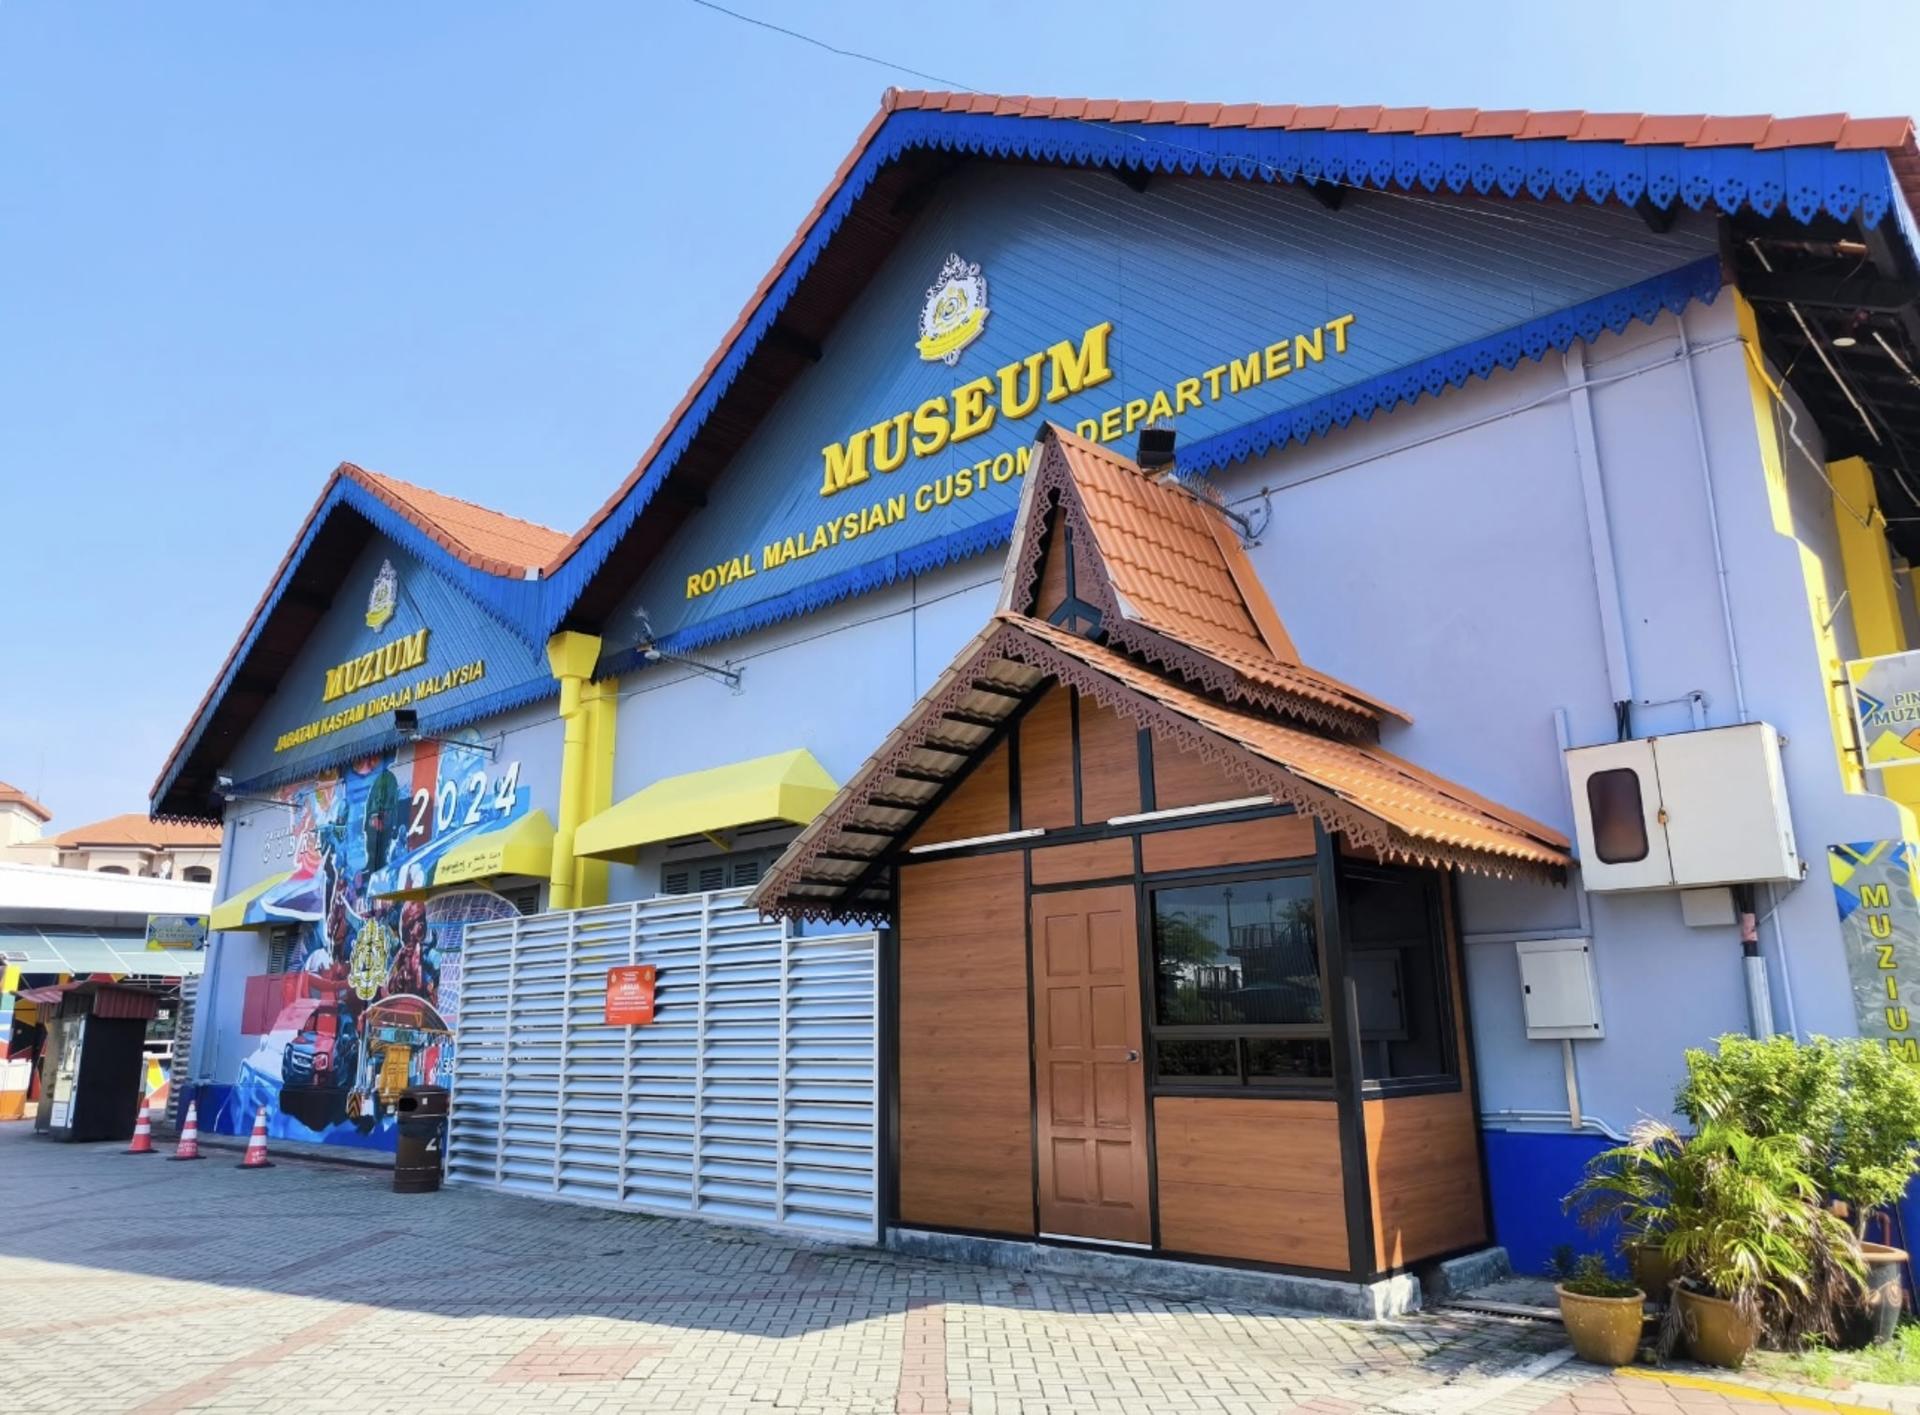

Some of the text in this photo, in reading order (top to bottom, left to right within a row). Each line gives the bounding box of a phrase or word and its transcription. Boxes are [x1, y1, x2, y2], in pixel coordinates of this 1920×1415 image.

[686, 313, 1355, 599] ROYAL MALAYSIAN CUSTOM DEPARTMENT
[819, 320, 1112, 497] MUSEUM
[274, 659, 486, 754] JABATAN KASTAM DIRAJA MALAYSIA
[322, 628, 429, 703] MUZIUM
[406, 761, 521, 838] 2024
[1859, 883, 1920, 1063] MUZIUM
